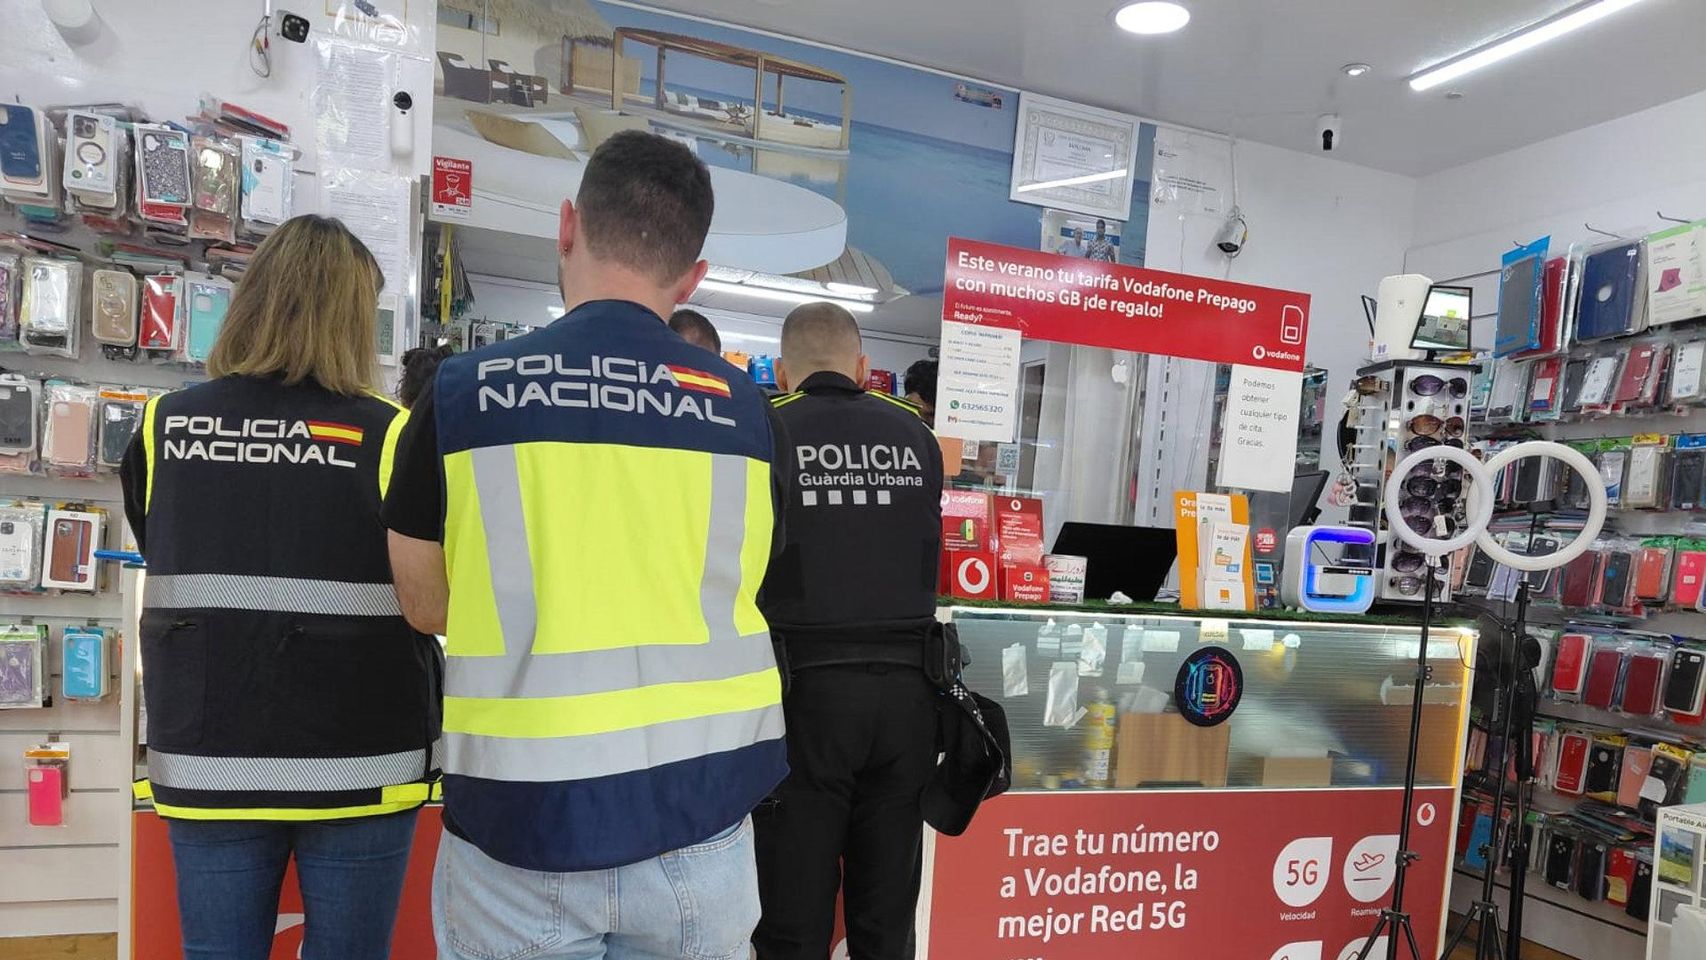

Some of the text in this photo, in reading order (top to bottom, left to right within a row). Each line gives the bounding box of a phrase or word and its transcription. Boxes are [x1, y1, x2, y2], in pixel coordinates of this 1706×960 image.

[436, 159, 470, 170] Vigilante
[958, 251, 1257, 314] Este verano tu tarifa Vodafone Prepago
[955, 277, 1164, 319] con muchos GB ¡de regalo!
[954, 311, 983, 323] Ready?
[1266, 350, 1301, 362] vodafone
[1243, 378, 1276, 390] Podemos
[478, 381, 737, 428] NACIONAL
[1242, 394, 1270, 403] obtener
[1240, 408, 1288, 421] cualquier tipo
[1239, 423, 1247, 431] de
[164, 439, 357, 468] NACIONAL
[796, 444, 922, 471] POLICIA
[798, 472, 923, 487] Guàrdia Urbana
[951, 495, 984, 504] vodafone
[1180, 497, 1197, 507] Ora
[1012, 584, 1044, 593] Vodafone
[1014, 591, 1041, 601] Prepago
[1663, 813, 1695, 826] Portable
[1004, 824, 1219, 857] Trae tu número
[1286, 859, 1319, 886] 5G
[1000, 863, 1198, 898] a Vodafone, la
[1279, 907, 1382, 922] Velocidad Roaming
[998, 901, 1187, 943] mejor Red 5G
